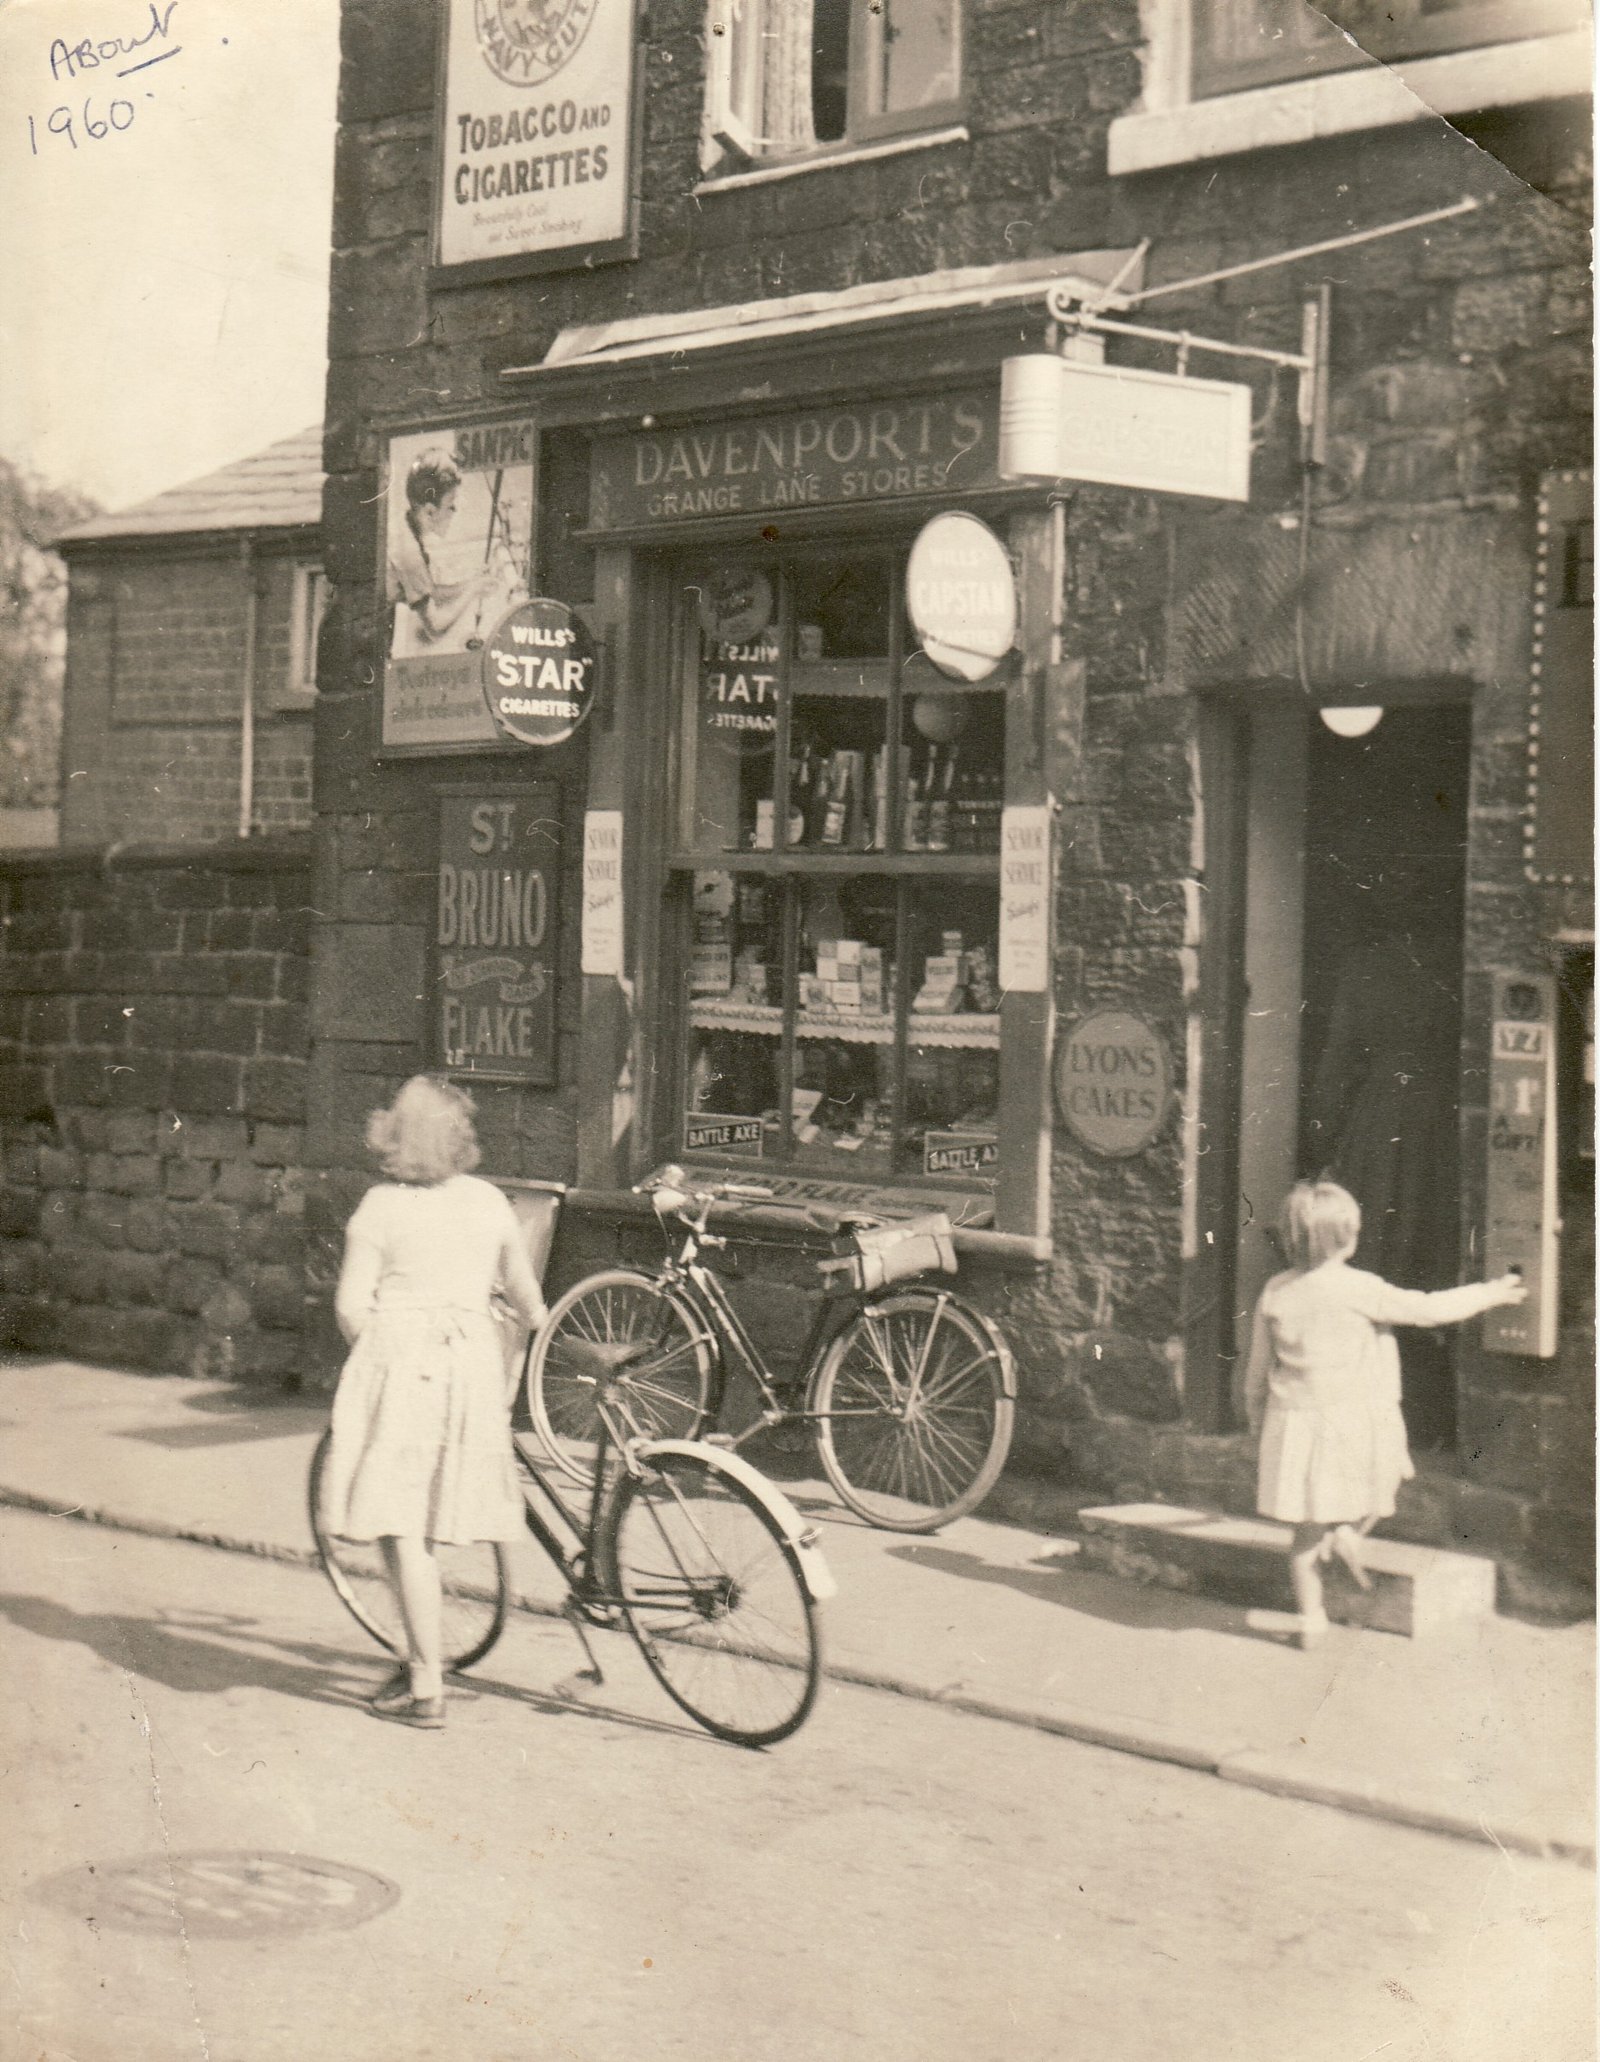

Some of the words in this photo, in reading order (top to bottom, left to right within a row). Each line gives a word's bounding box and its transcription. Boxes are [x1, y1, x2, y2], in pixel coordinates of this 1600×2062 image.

[28, 97, 134, 154] 1960
[457, 99, 577, 154] TOBACCO
[579, 104, 611, 131] AND
[455, 144, 609, 205] CIGARETTES
[648, 484, 742, 516] GRANGE
[760, 475, 821, 505] LANE
[842, 462, 947, 496] STORES
[499, 697, 580, 717] CIGARETTES
[438, 863, 547, 947] BRUNO
[442, 995, 534, 1057] FLAKE
[1071, 1044, 1156, 1076] LYONS
[1070, 1086, 1156, 1120] CAKES
[688, 1126, 730, 1147] BATTLE
[734, 1124, 759, 1141] AXE
[930, 1147, 978, 1170] BATTLE
